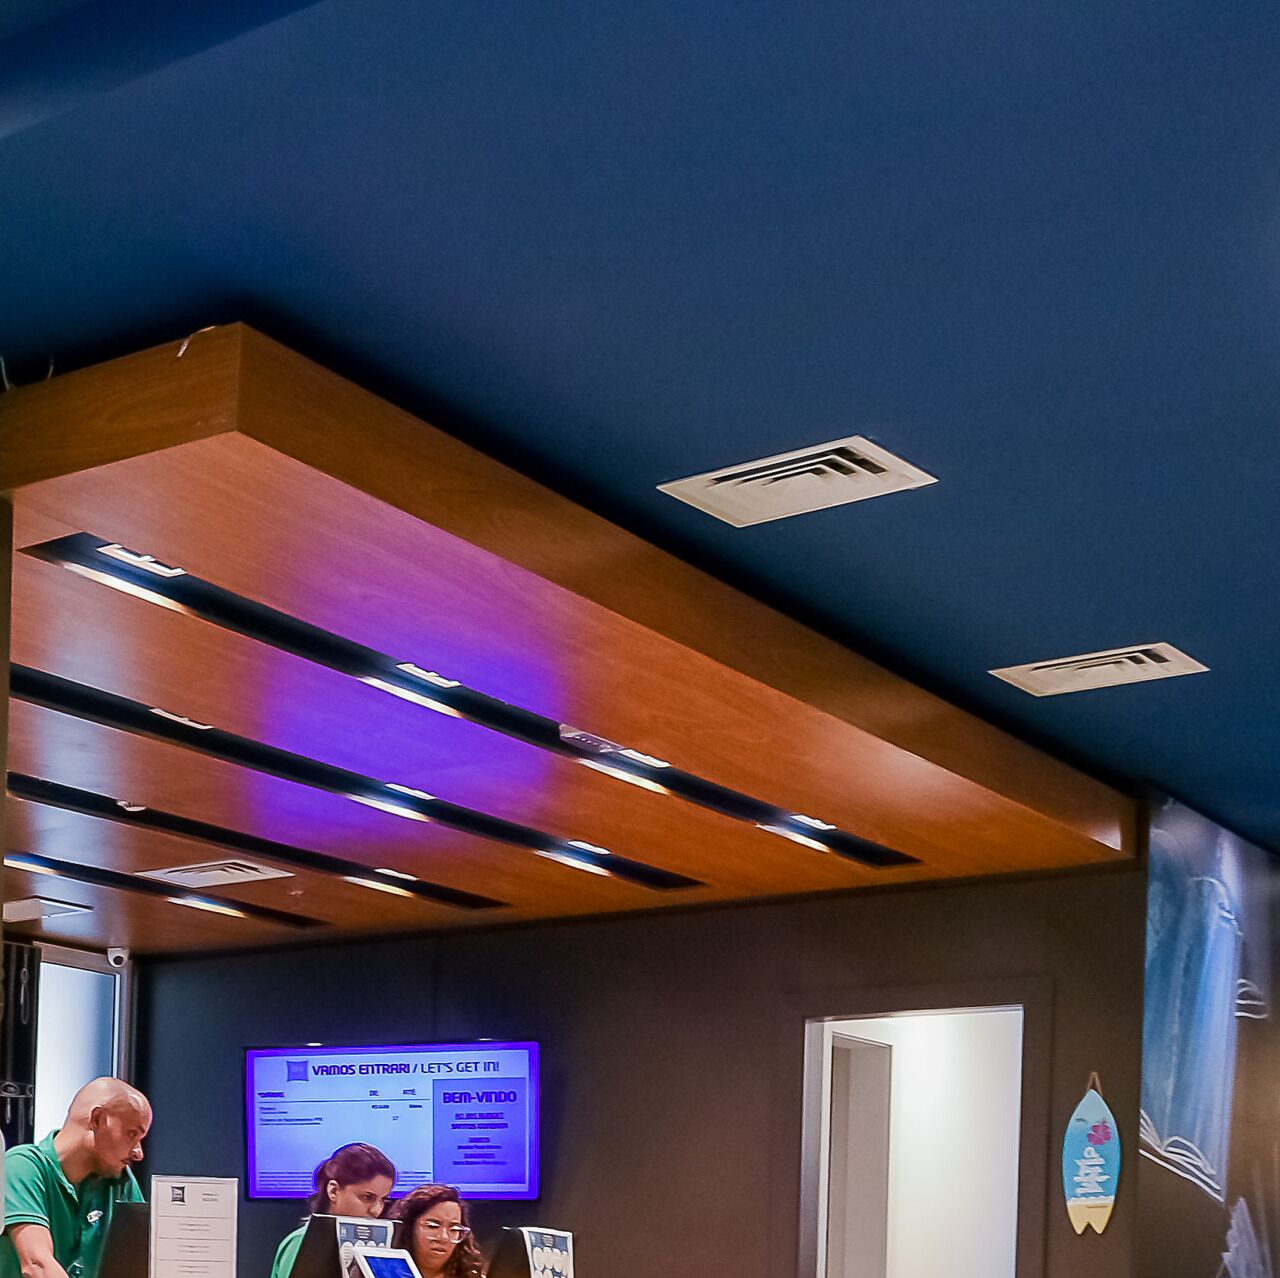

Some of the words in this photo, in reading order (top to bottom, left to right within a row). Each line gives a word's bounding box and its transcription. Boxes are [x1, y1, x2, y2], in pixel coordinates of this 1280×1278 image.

[312, 1064, 356, 1076] VAMOS
[456, 1062, 479, 1072] GET
[443, 1090, 517, 1103] BEM-VINDO
